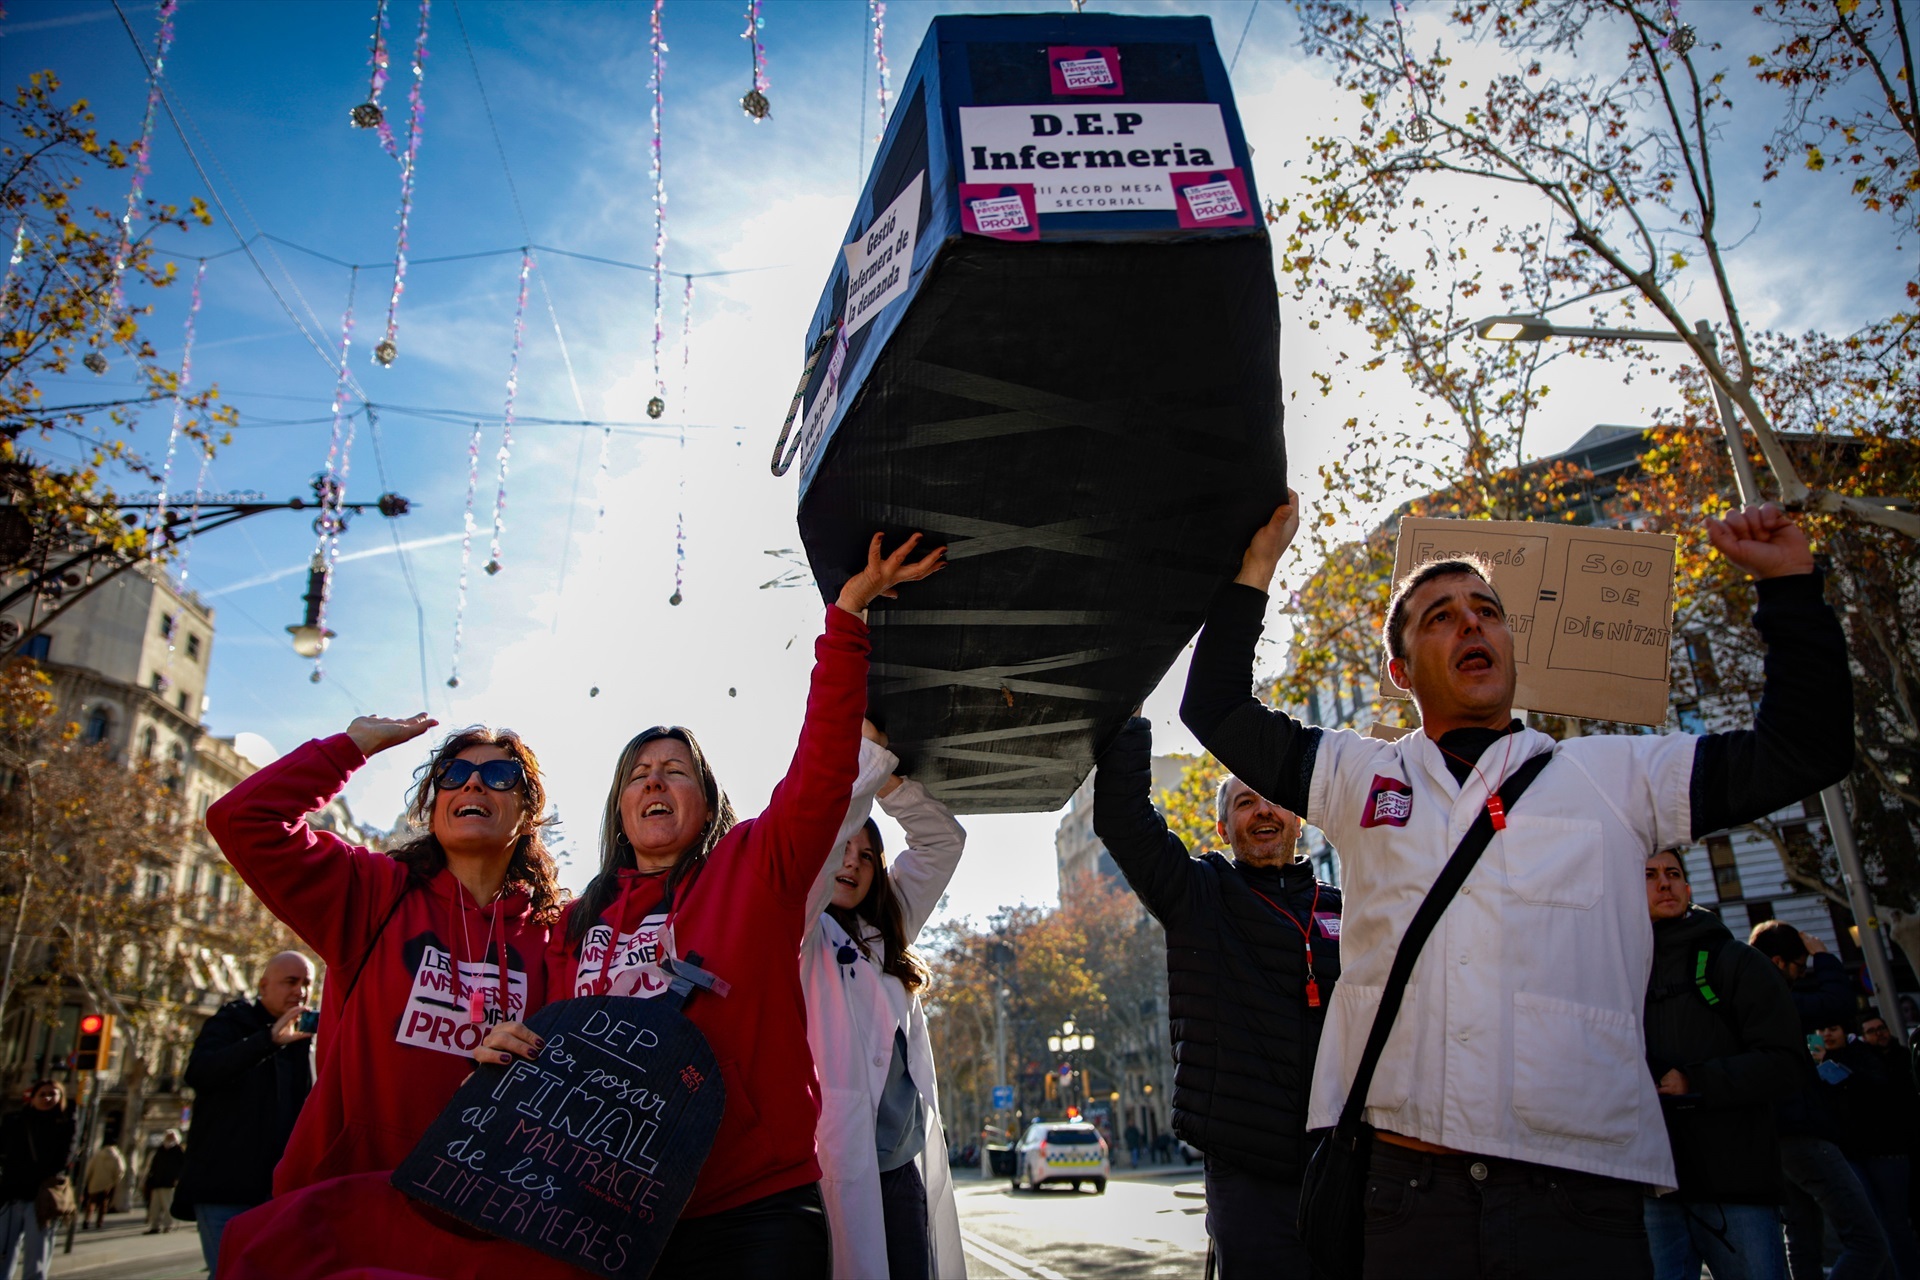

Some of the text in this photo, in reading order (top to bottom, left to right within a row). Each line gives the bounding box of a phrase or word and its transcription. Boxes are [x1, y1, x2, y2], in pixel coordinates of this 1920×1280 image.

[1068, 76, 1111, 86] PROU!
[1030, 112, 1142, 136] D.E.P
[971, 143, 1213, 170] Infermeria
[1056, 198, 1144, 208] SECTORIAL
[1060, 185, 1112, 194] ACORD
[1122, 184, 1162, 192] MESA
[1195, 202, 1240, 216] PROU!
[866, 209, 896, 256] Gestió
[981, 216, 1026, 229] PROU!
[849, 229, 909, 300] infermera de
[848, 264, 900, 325] la demanda
[1582, 554, 1652, 577] SOU
[1602, 587, 1640, 607] DE
[406, 1010, 494, 1050] PRO
[582, 1010, 658, 1052] DEP
[584, 1068, 666, 1121] posar
[492, 1060, 658, 1174] FINAL
[446, 1138, 562, 1200] de les
[461, 1105, 664, 1210] al MALTRACTE
[412, 1154, 632, 1272] INFERMERES
